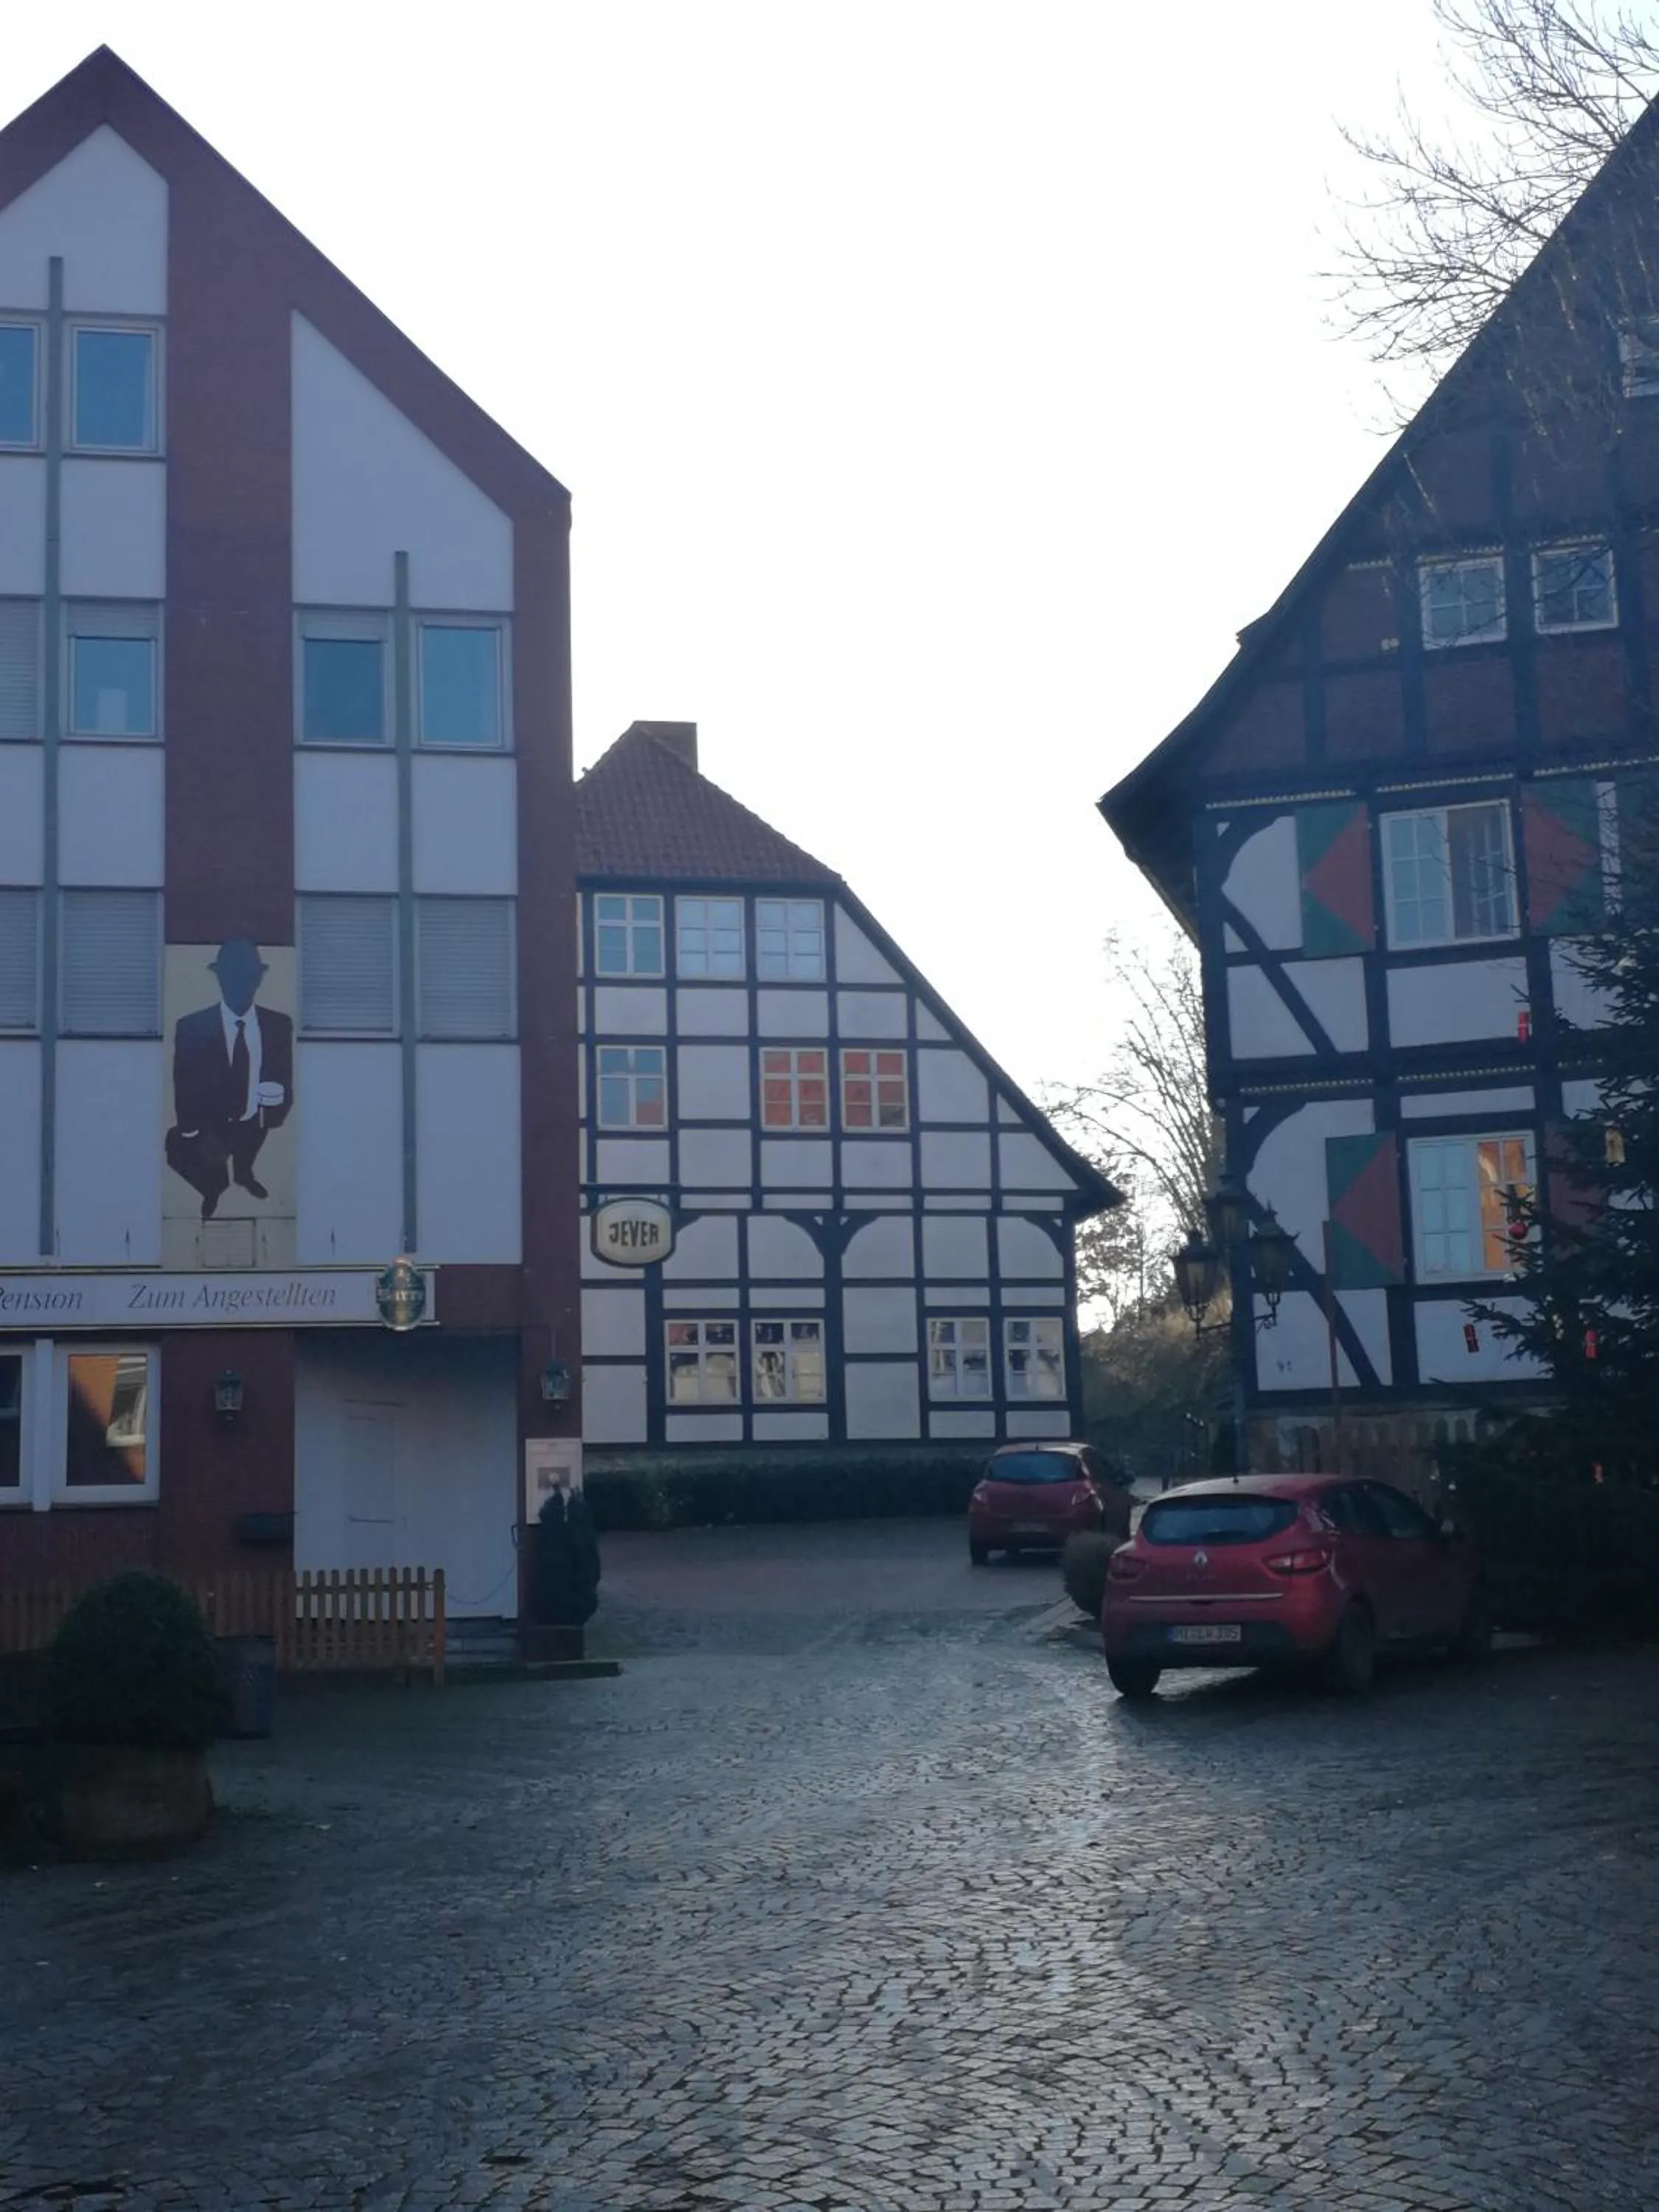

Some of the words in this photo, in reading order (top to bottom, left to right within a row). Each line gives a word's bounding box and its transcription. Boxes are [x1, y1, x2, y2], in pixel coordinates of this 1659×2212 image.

[608, 1219, 660, 1248] JEVER
[128, 1284, 185, 1309] Zum
[192, 1282, 337, 1314] Angestellten
